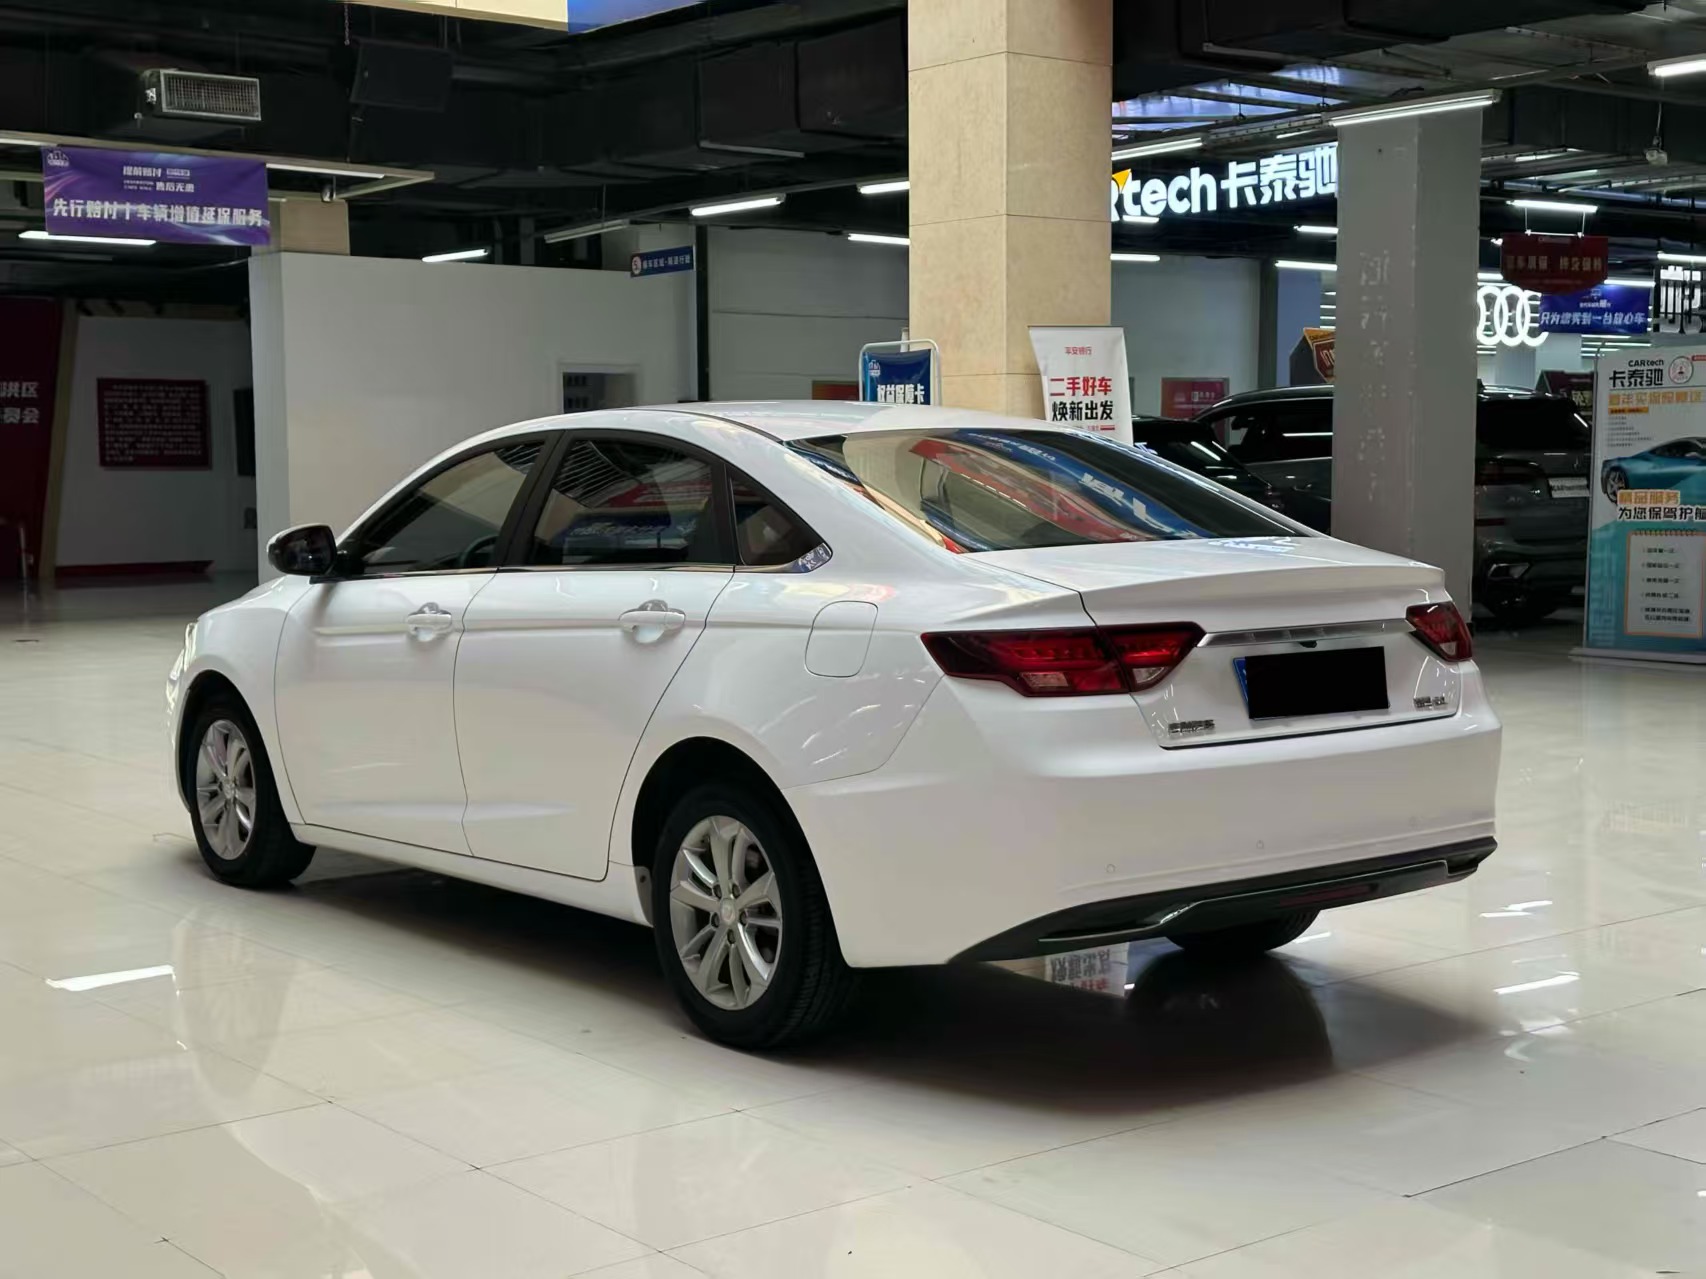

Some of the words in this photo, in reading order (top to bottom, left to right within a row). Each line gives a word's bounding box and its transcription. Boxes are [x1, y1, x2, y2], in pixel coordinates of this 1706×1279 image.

[1220, 145, 1338, 208] 卡泰驰
[1628, 359, 1664, 367] CARtech
[1049, 376, 1113, 396] 二手好车
[1609, 368, 1664, 388] 卡泰驰
[0, 381, 39, 398] 洪区
[877, 383, 925, 404] 权益保障卡
[1051, 400, 1114, 421] 焕新出发
